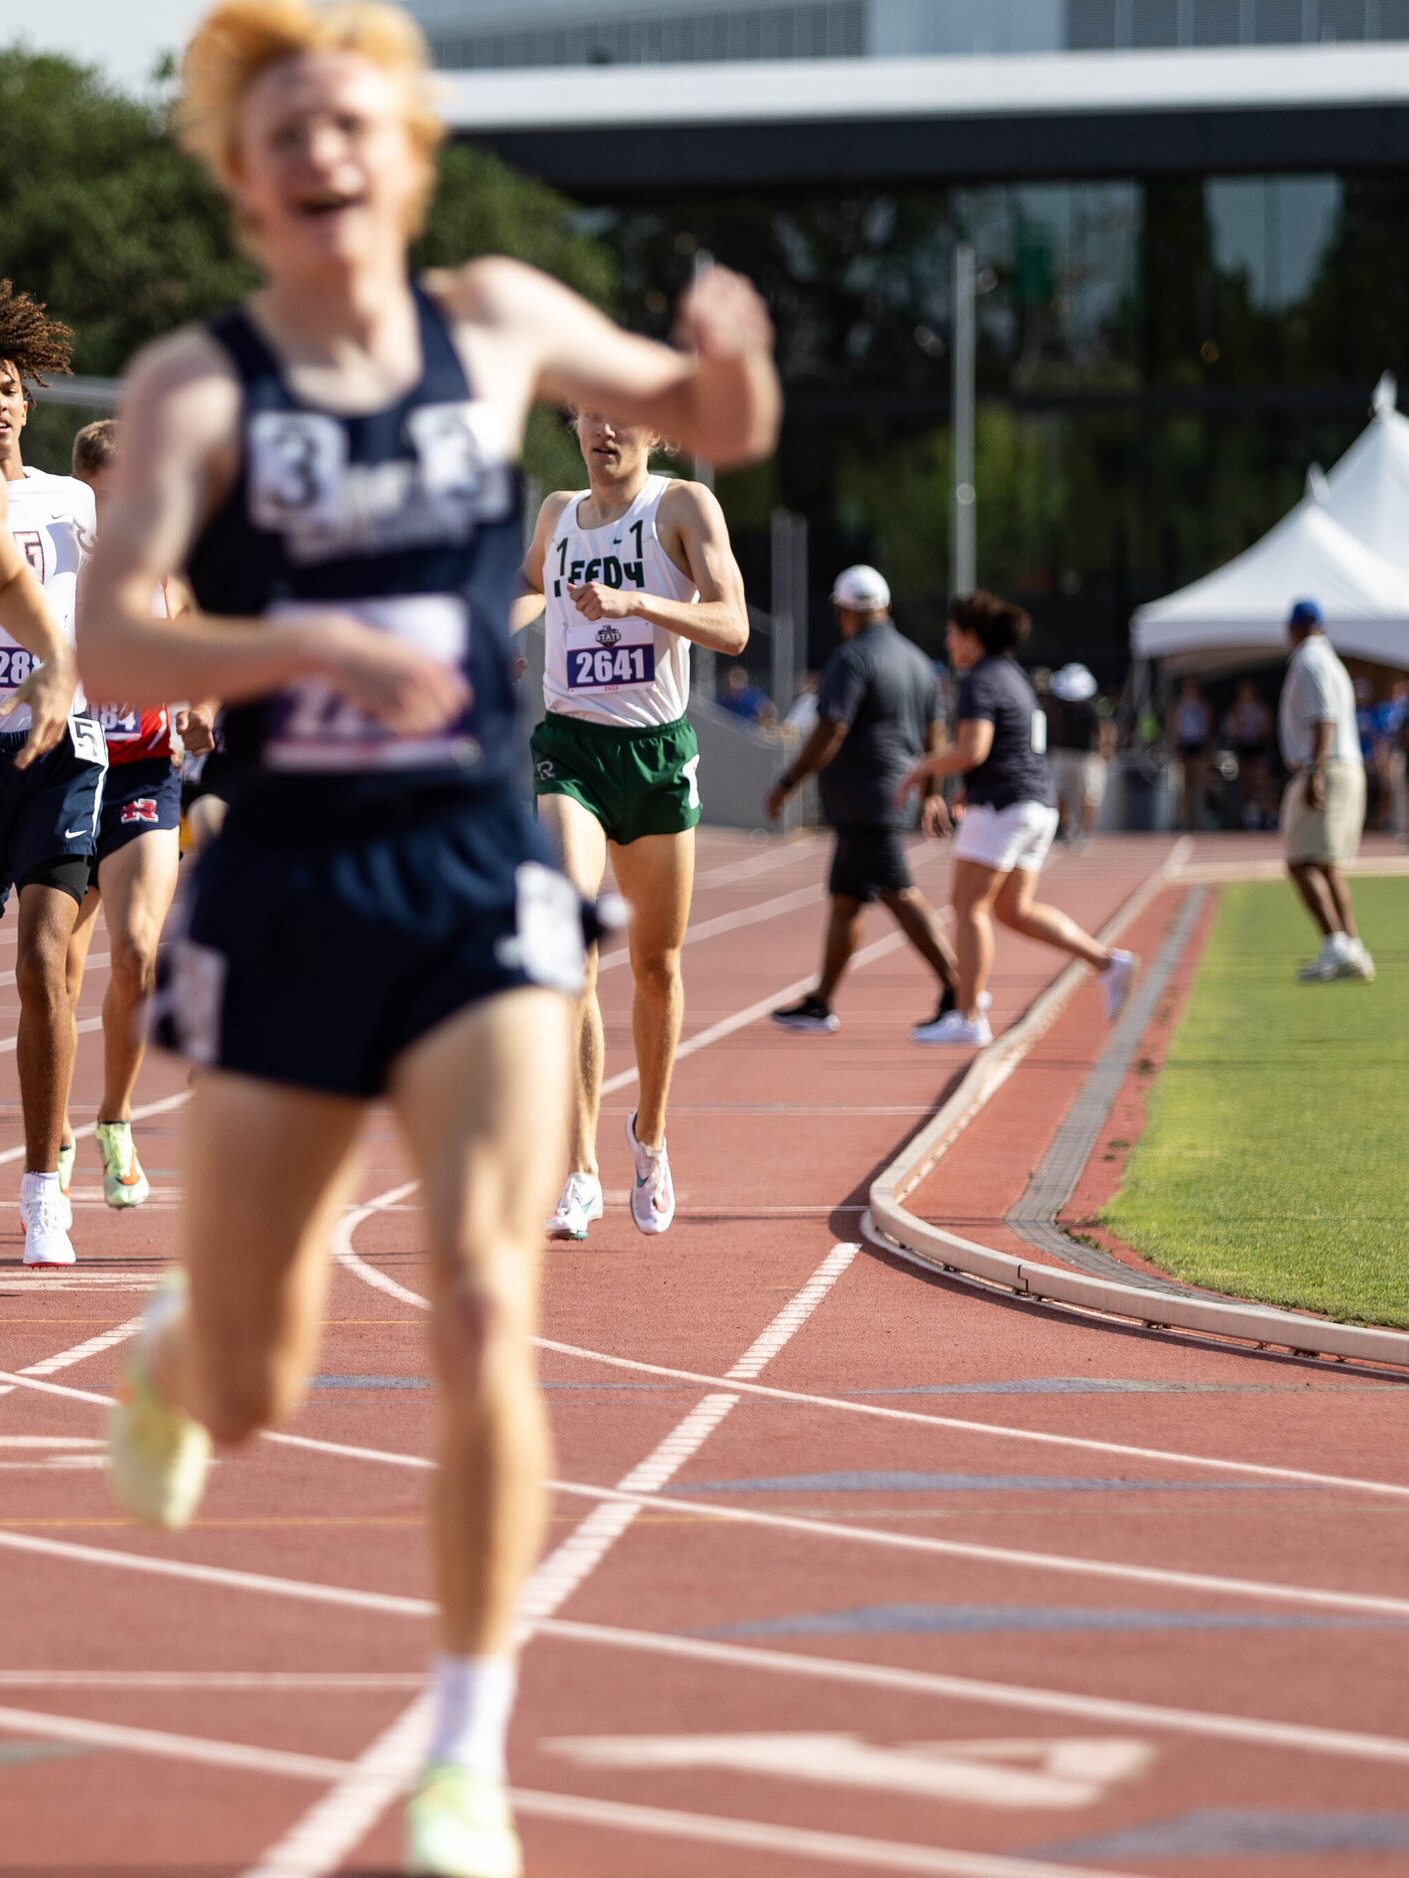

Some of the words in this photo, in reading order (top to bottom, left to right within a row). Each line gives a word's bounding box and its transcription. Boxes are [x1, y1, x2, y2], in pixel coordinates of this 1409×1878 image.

[556, 537, 569, 577] 1
[629, 519, 644, 559] 1
[554, 555, 645, 597] EEDY
[576, 648, 645, 684] 2641
[75, 720, 97, 757] 5
[536, 760, 556, 781] R
